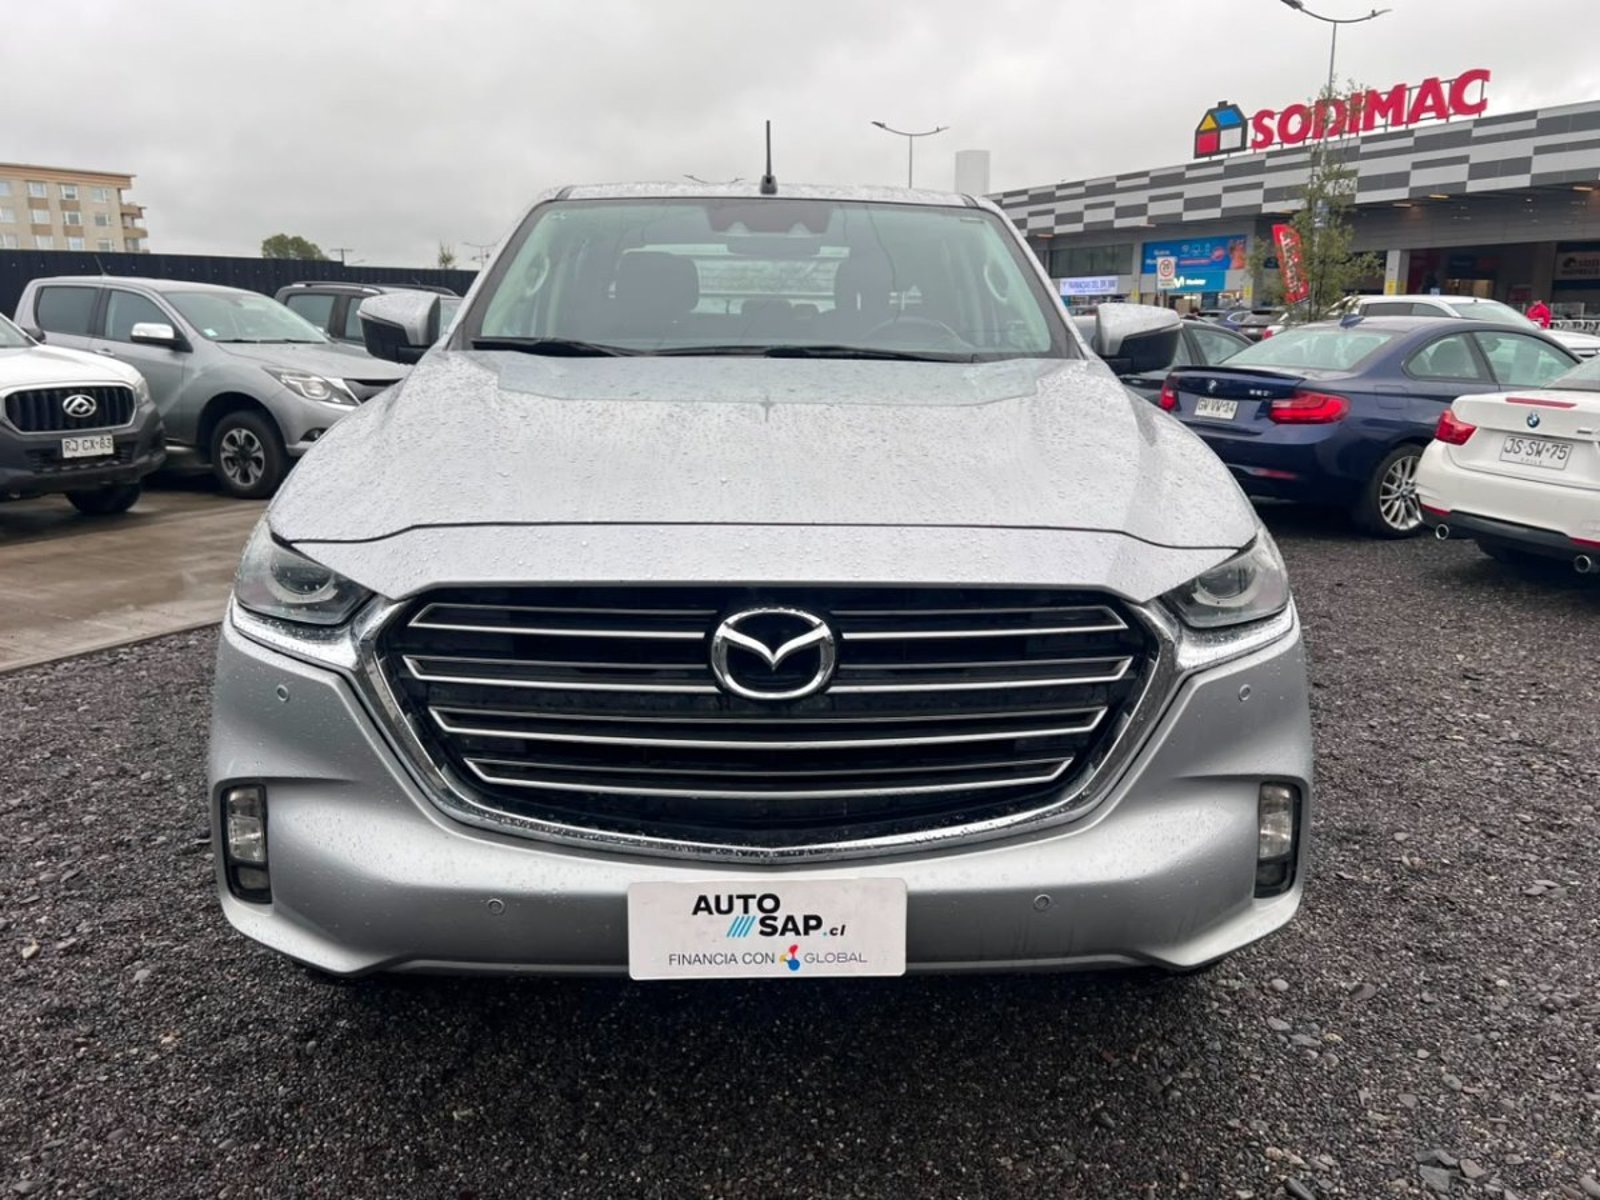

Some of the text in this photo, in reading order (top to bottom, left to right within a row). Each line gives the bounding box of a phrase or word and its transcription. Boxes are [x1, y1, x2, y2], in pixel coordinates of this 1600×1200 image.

[1251, 69, 1490, 149] SODIMAC
[692, 893, 781, 915] AUTO
[668, 951, 868, 966] FINANCIA CON GLOBAL
